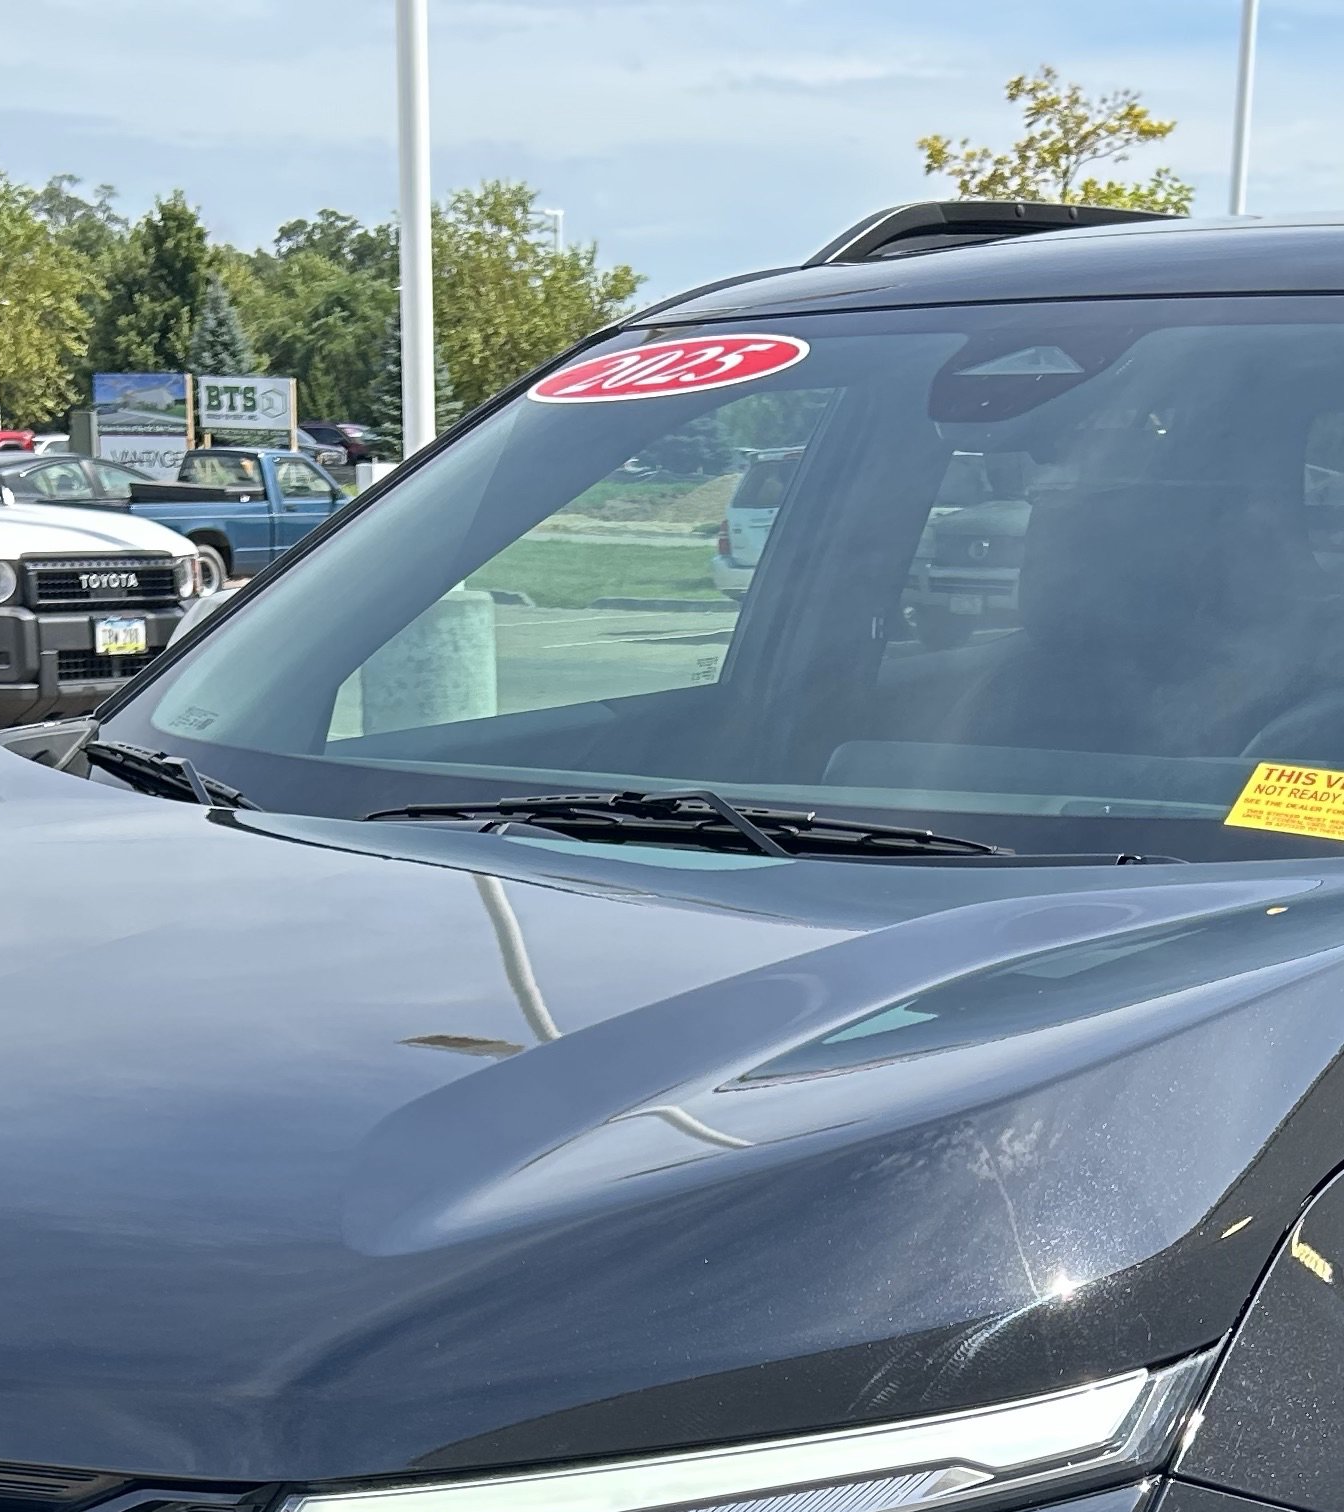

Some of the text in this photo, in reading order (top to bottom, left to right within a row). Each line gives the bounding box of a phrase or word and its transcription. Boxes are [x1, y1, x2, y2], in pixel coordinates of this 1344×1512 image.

[554, 343, 777, 396] 2025
[205, 385, 257, 412] BTS
[79, 572, 139, 590] TOYOTA
[1263, 767, 1319, 786] THIS
[1254, 783, 1288, 796] NOT
[1288, 788, 1341, 804] READY
[1265, 800, 1283, 808] THE
[1285, 803, 1323, 812] DEALER
